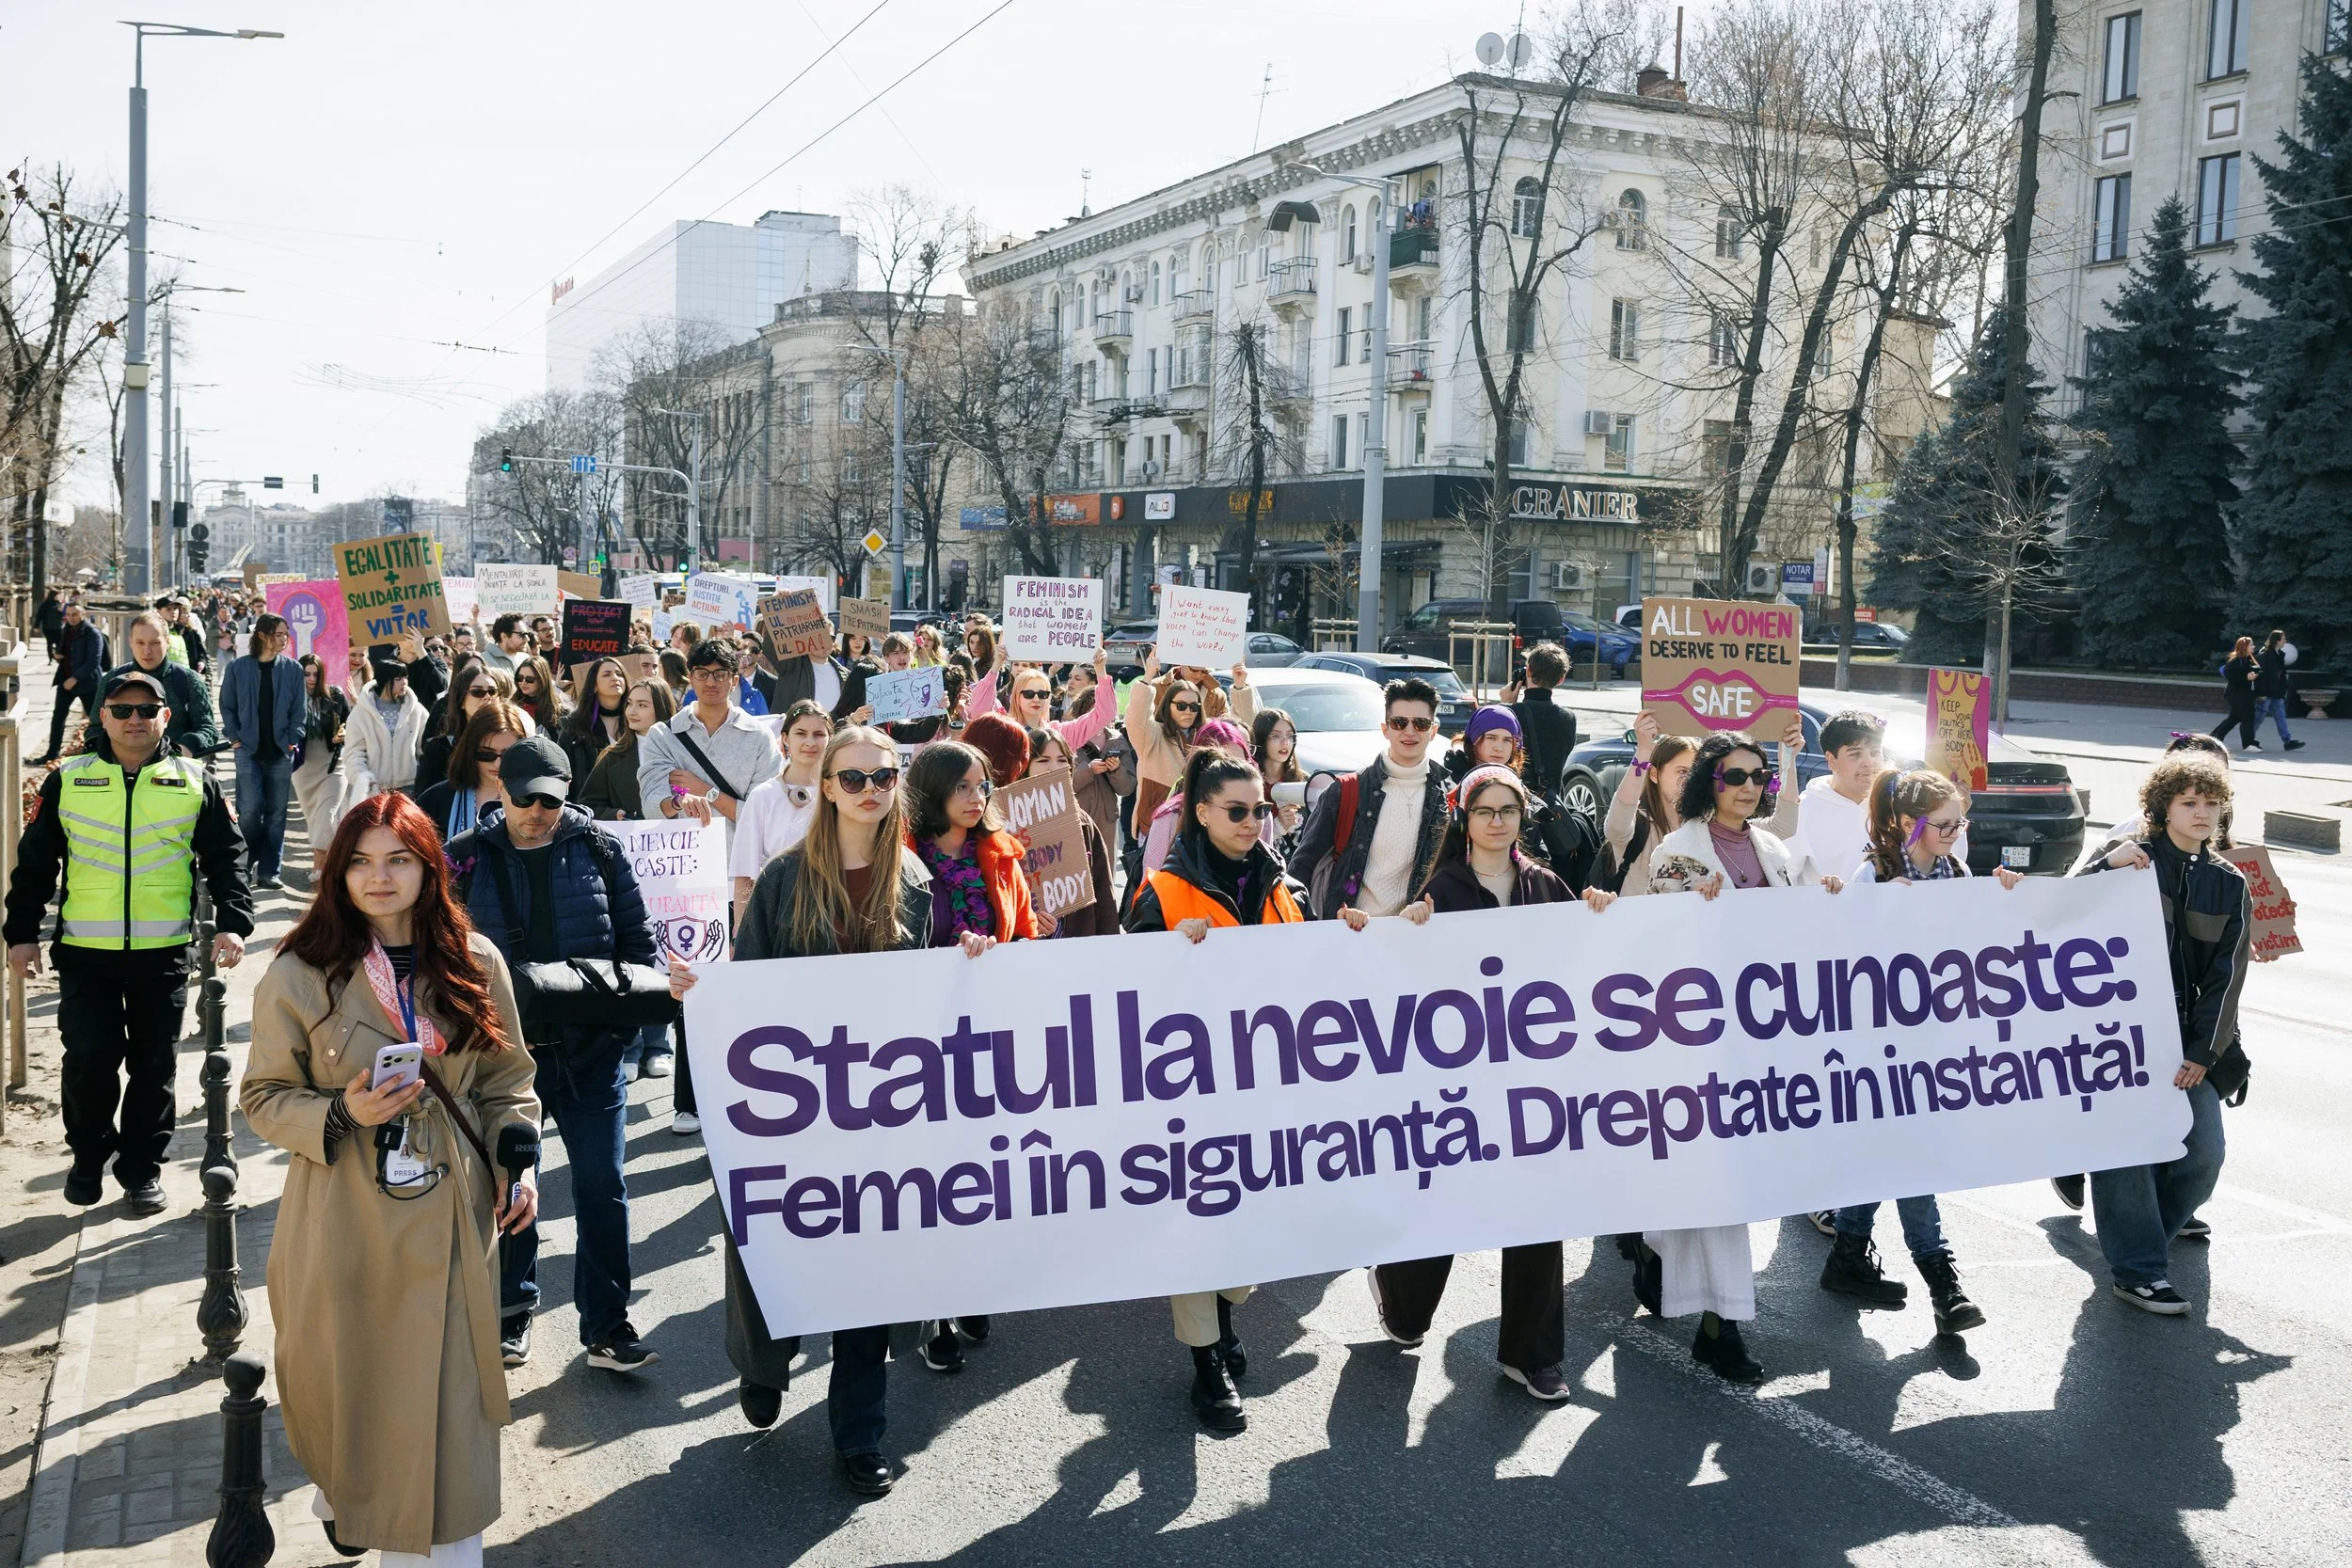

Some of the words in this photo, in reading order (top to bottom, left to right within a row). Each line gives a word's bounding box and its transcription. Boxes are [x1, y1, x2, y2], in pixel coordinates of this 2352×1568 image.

[1512, 484, 1638, 519] GRANIER
[344, 537, 432, 576] EGALITATE
[528, 569, 539, 578] SE
[1786, 564, 1811, 575] NOTAR
[694, 578, 730, 594] DREPTURI.
[1017, 580, 1089, 598] FEMINISM
[347, 580, 441, 610] SOLIDARITATE
[541, 593, 550, 601] LA
[1040, 598, 1048, 607] is
[850, 602, 882, 619] SMASH
[1009, 606, 1056, 619] RADICAL
[1061, 608, 1093, 621] IDEA
[366, 609, 431, 639] VIITOR
[769, 615, 785, 627] UL
[843, 614, 857, 627] THE
[1018, 620, 1037, 628] that
[1650, 605, 1702, 636] ALL
[1703, 609, 1792, 639] WOMEN
[571, 639, 619, 653] EDUCATE
[1048, 630, 1096, 649] PEOPLE
[777, 642, 792, 655] UL
[1650, 640, 1714, 659] DESERVE
[1720, 643, 1740, 658] TO
[1745, 642, 1792, 665] FEEL
[1692, 685, 1754, 718] SAFE
[1940, 699, 1961, 712] KEEP
[1939, 718, 1965, 729] POLITICS
[1938, 727, 1954, 738] OFF
[1957, 729, 1972, 740] HER
[1945, 740, 1965, 752] BODY
[629, 830, 701, 853] NEVOIE
[1042, 870, 1087, 913] BODY
[2251, 897, 2294, 921] otect
[725, 993, 1097, 1138] Statul
[1116, 990, 1216, 1102] la
[1230, 956, 1578, 1091] nevoie
[1591, 967, 1726, 1053] se
[1735, 930, 2137, 1043] cunoaște:
[728, 1134, 1012, 1247] Femei
[1020, 1128, 1106, 1217] în
[1120, 1085, 1501, 1217] siguranță.
[1507, 1065, 1821, 1161] Dreptate
[1823, 1047, 1883, 1124] în
[1883, 1021, 2151, 1117] instanță!
